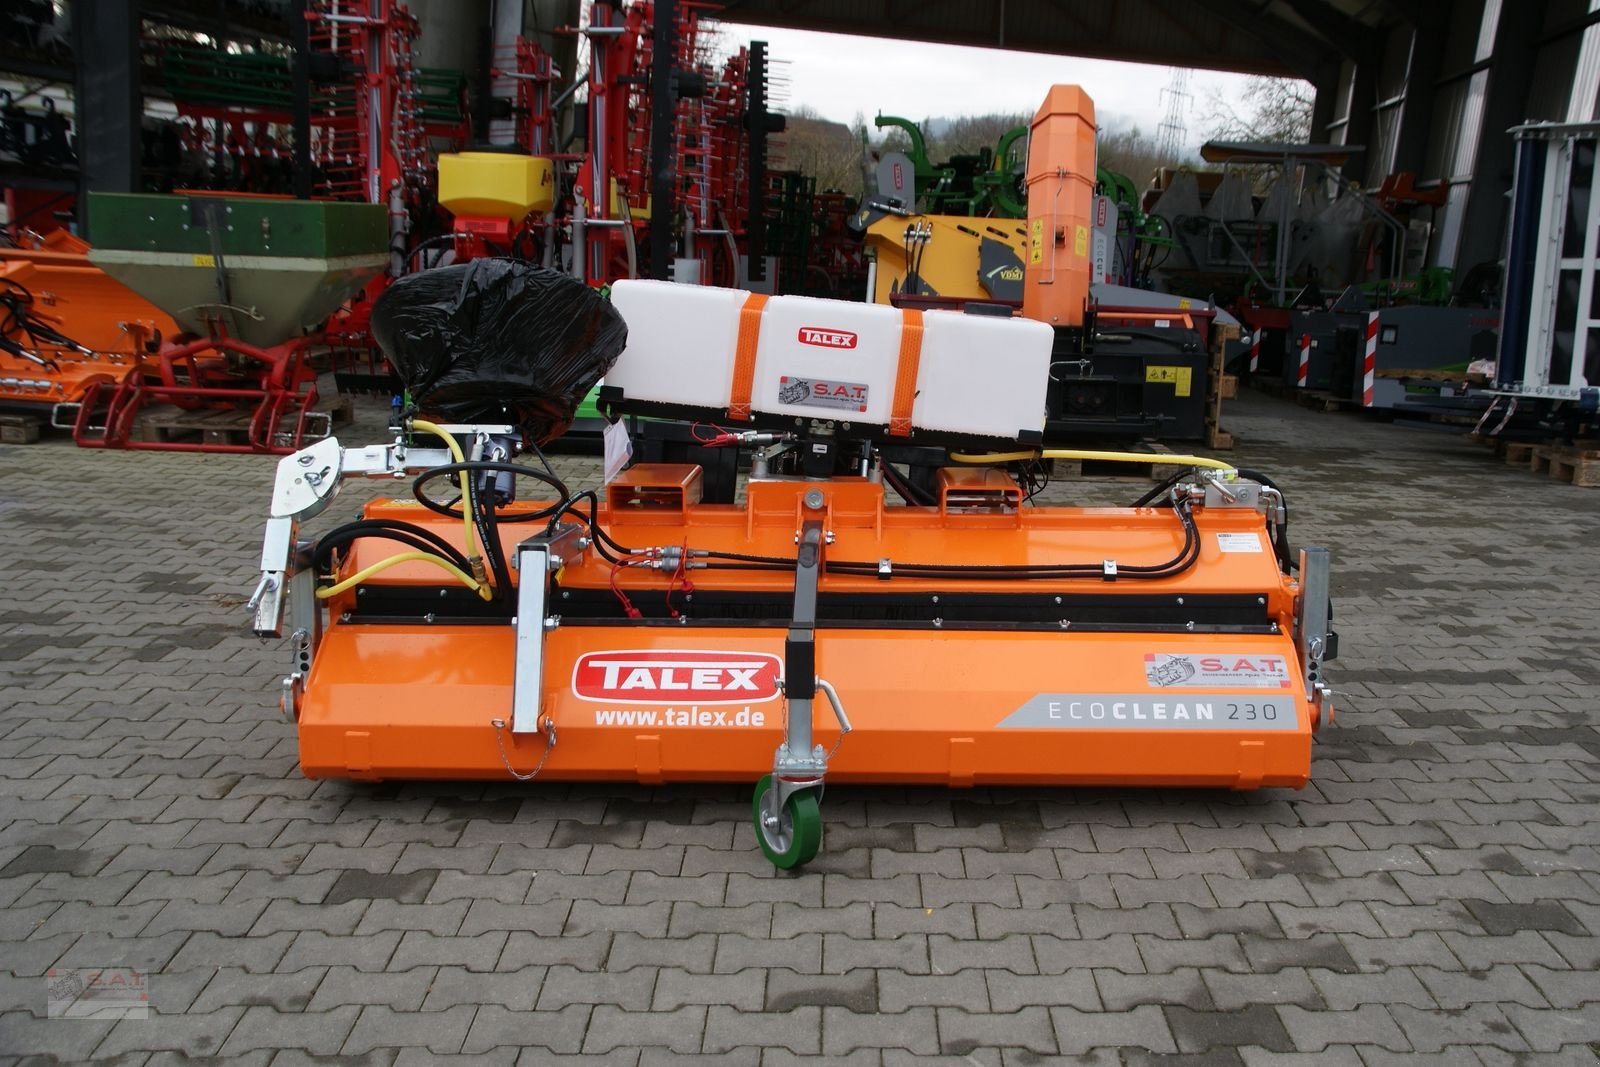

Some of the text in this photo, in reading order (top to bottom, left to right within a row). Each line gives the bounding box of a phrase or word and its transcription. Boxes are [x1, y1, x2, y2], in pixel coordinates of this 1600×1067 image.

[801, 328, 855, 347] TALEX
[813, 383, 866, 399] S.A.T.
[1199, 657, 1284, 673] S.A.T.
[588, 660, 769, 691] TALEX
[594, 706, 766, 727] www.talex.de
[1049, 702, 1278, 720] ECOCLEAN 230
